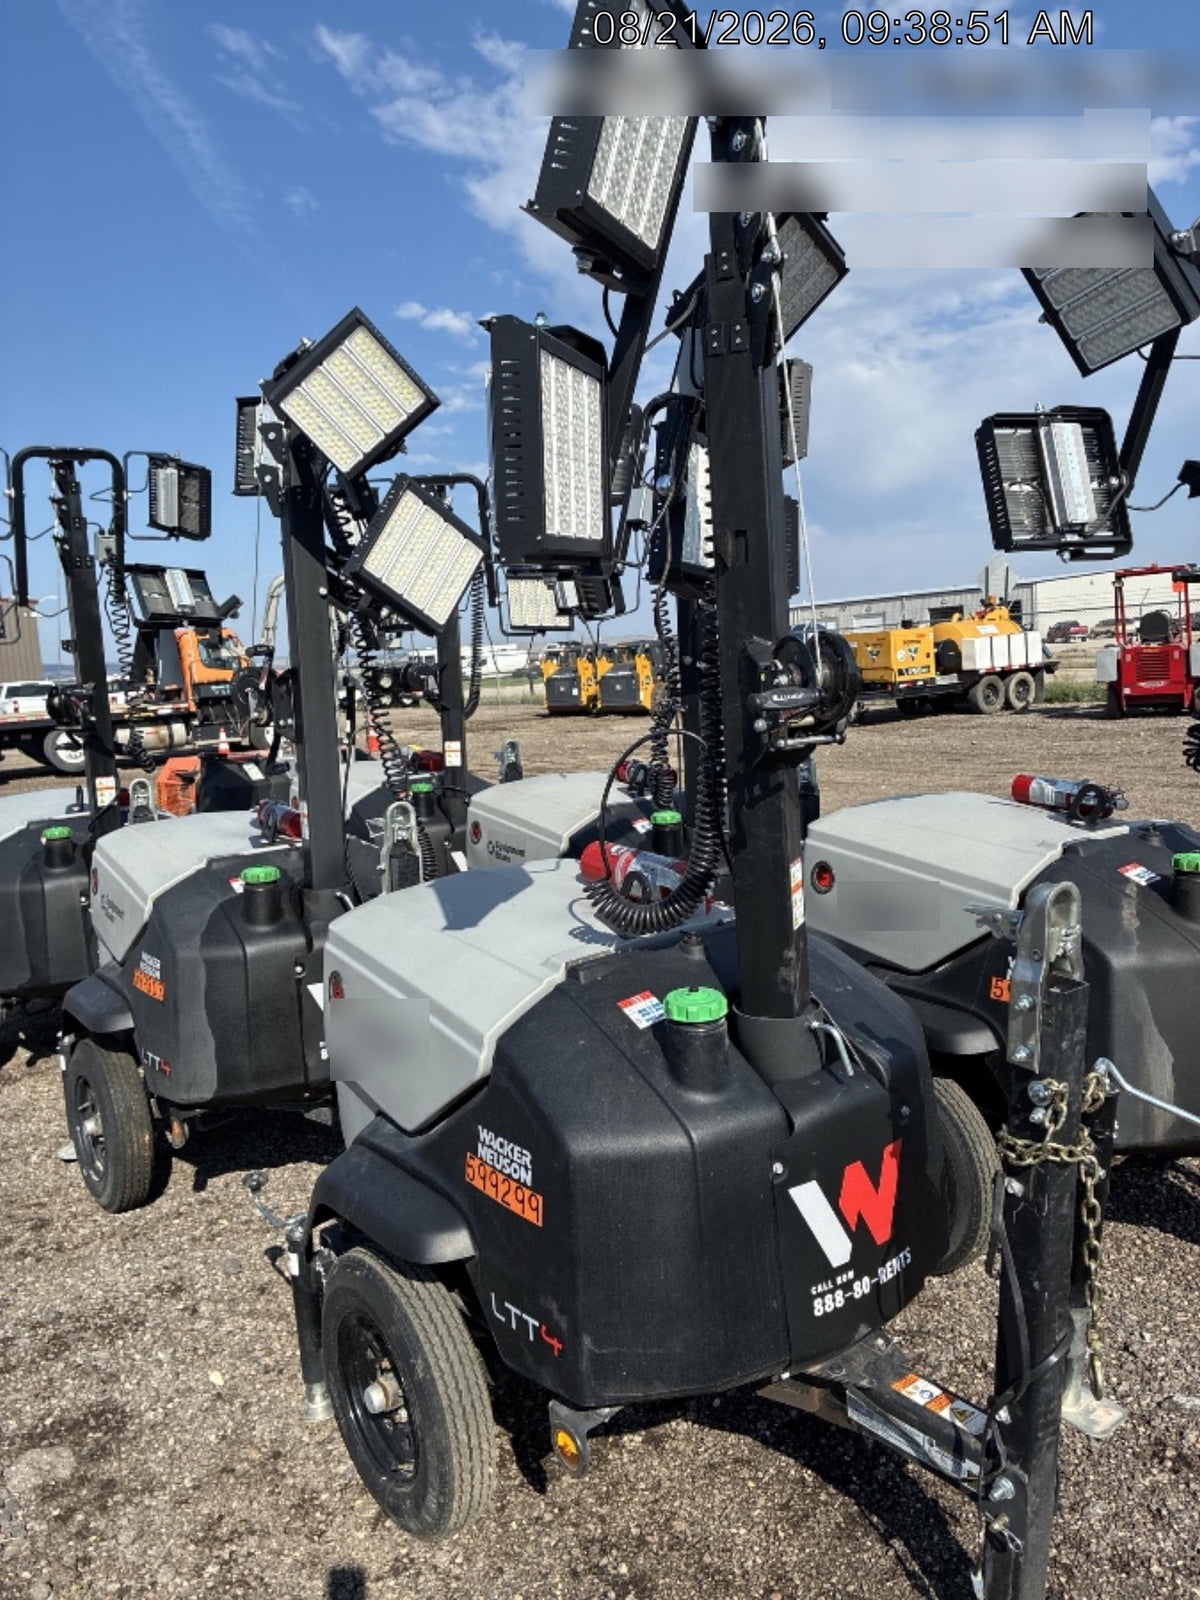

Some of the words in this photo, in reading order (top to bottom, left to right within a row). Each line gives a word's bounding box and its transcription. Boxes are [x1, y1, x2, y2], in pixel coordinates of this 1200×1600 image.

[477, 1124, 532, 1168] WACKER
[477, 1142, 533, 1187] NEUSON
[466, 1157, 541, 1224] 599299
[810, 1280, 835, 1295] CALL
[813, 1246, 912, 1317] 888-80-RENTS
[490, 1292, 564, 1357] LTT4
